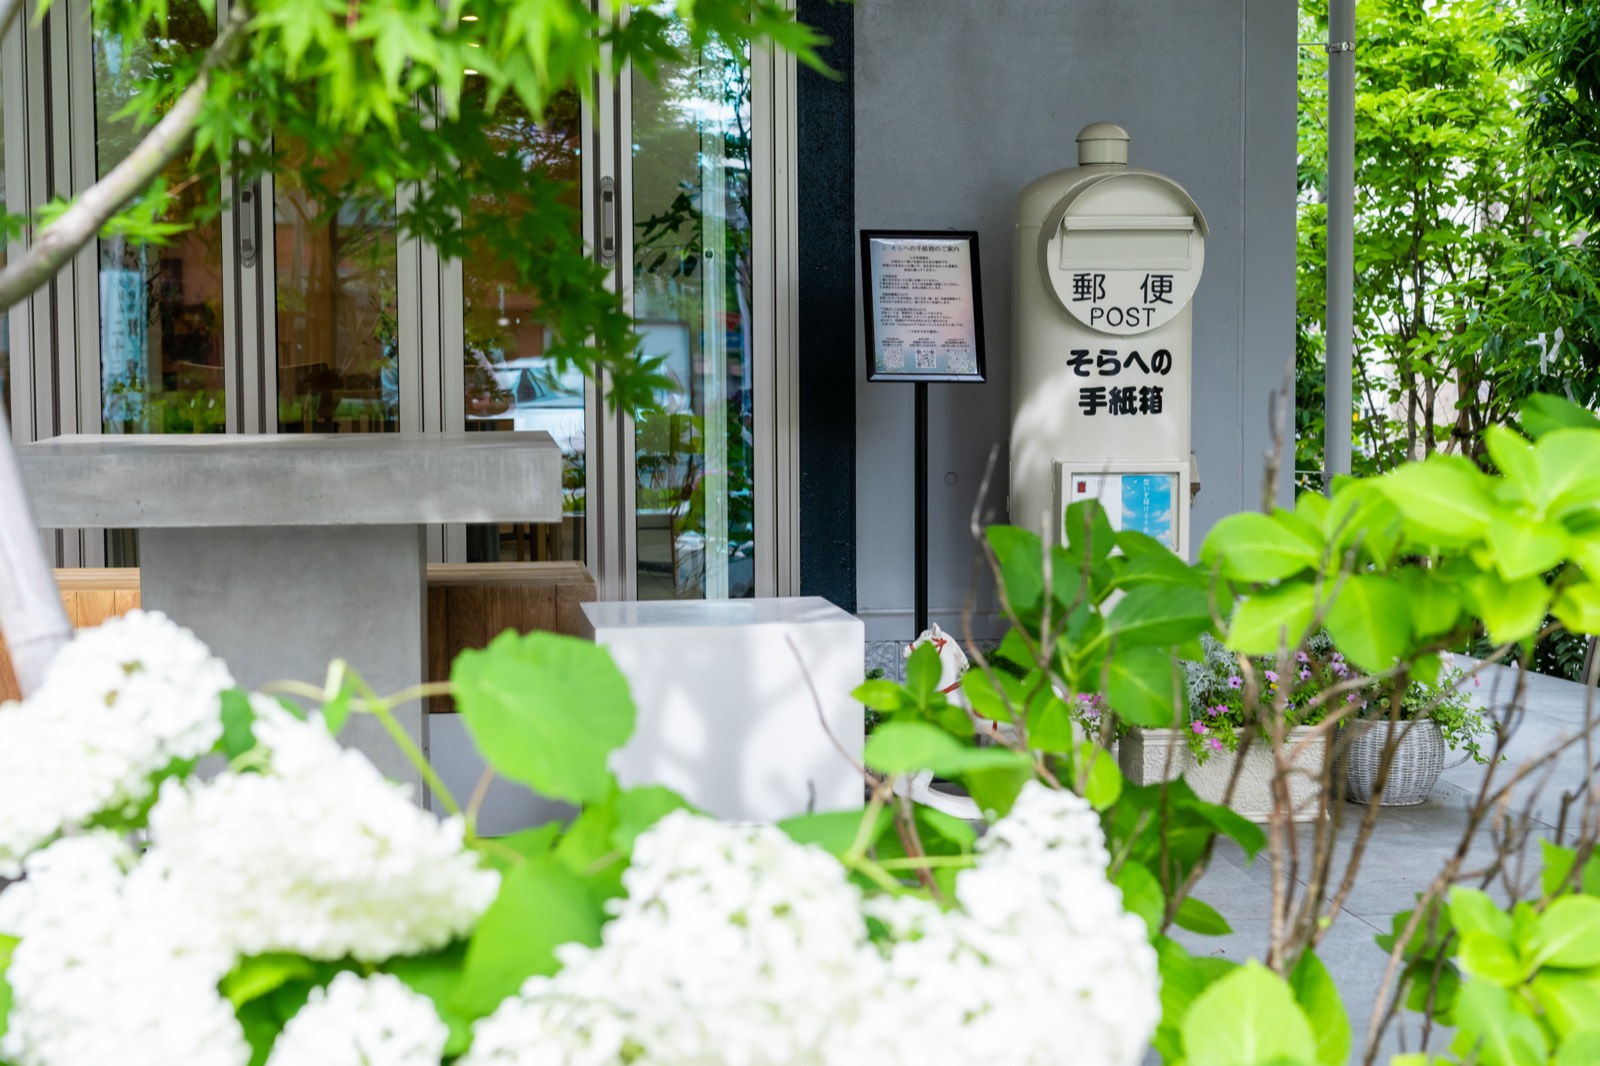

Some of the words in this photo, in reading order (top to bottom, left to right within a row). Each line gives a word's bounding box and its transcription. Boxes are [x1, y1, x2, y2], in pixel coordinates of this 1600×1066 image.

[1090, 307, 1156, 327] POST
[1066, 349, 1173, 377] そらへの
[1078, 385, 1164, 416] 手紙箱
